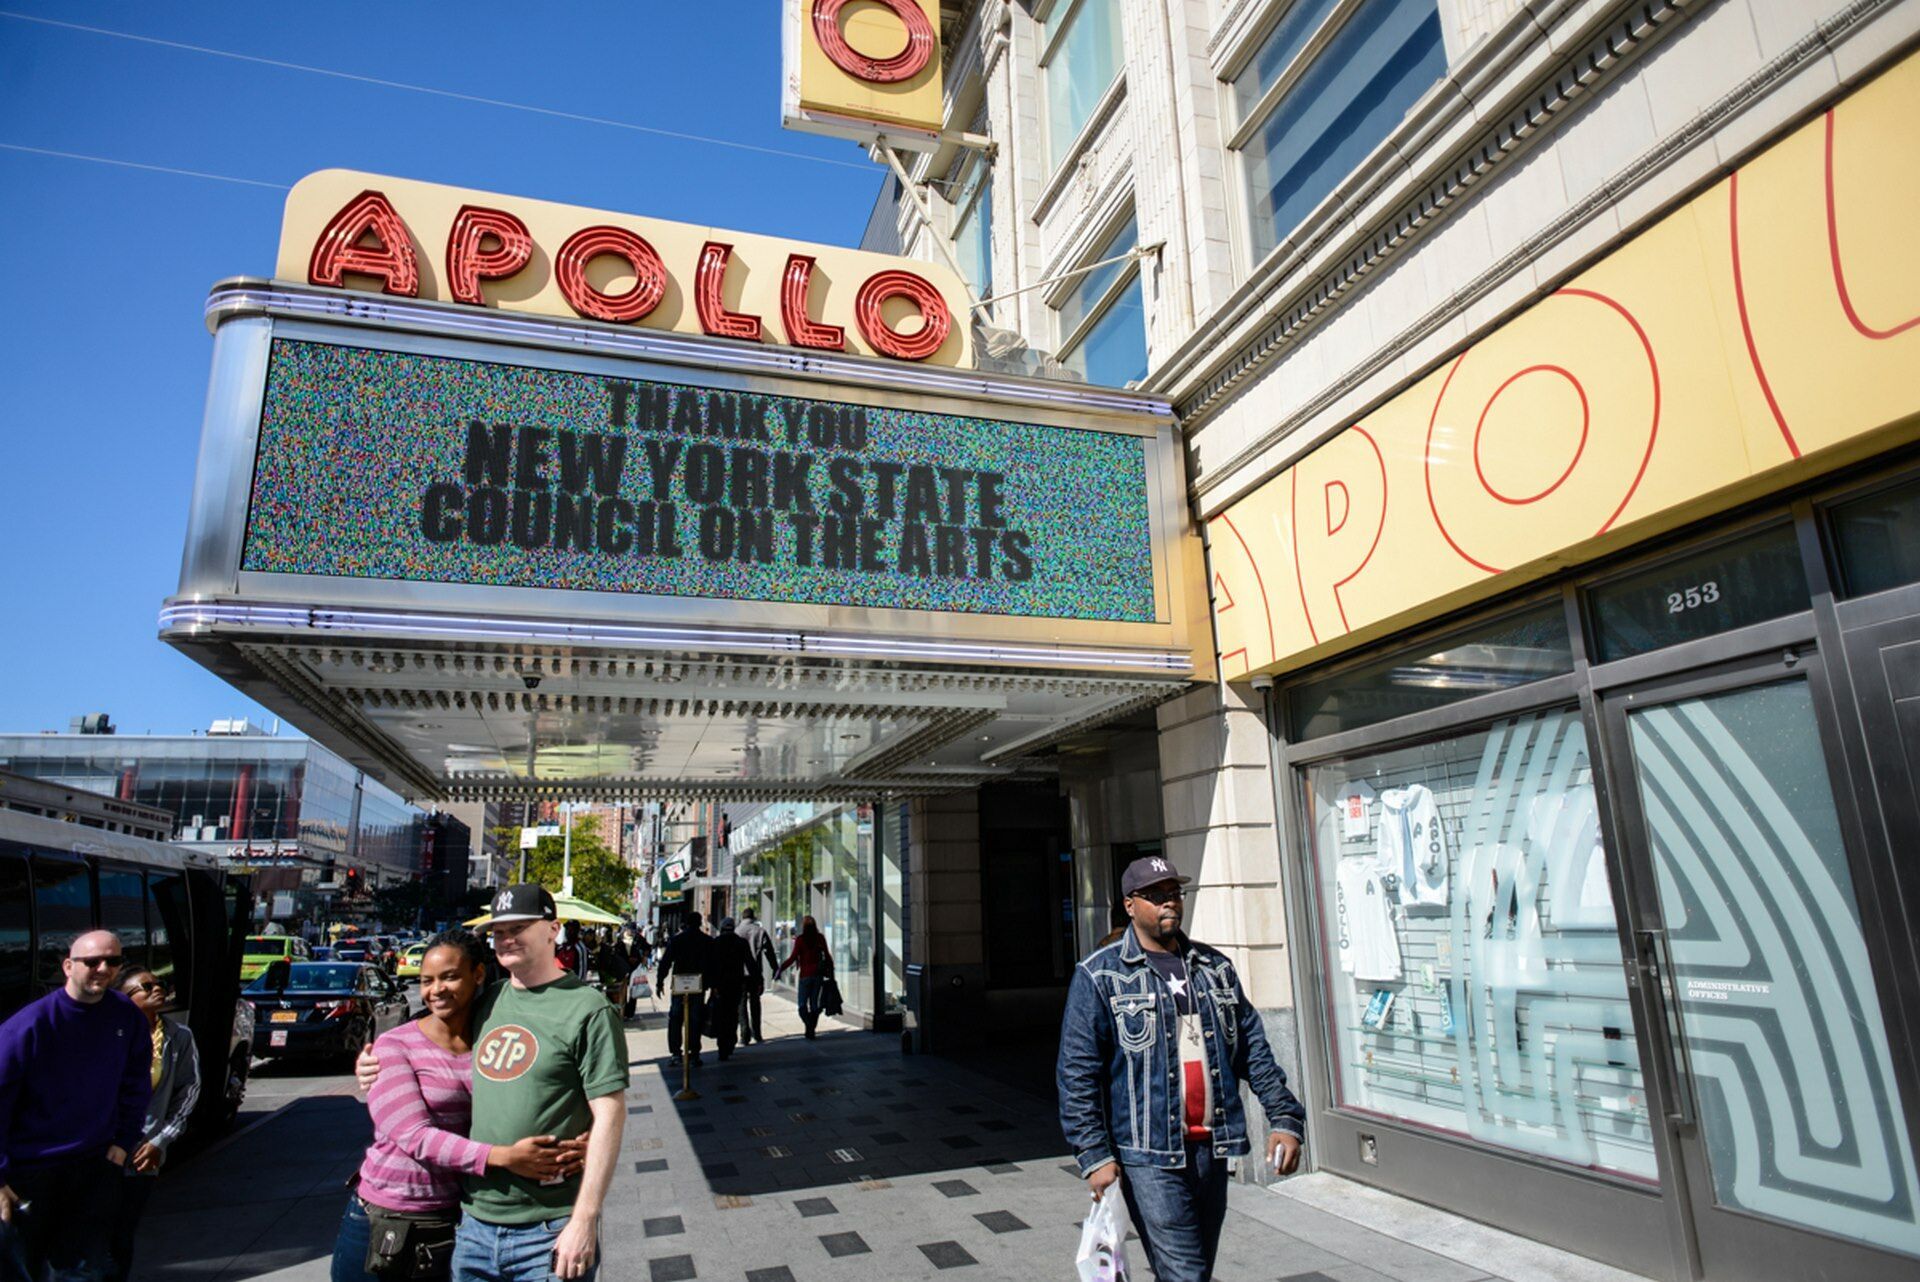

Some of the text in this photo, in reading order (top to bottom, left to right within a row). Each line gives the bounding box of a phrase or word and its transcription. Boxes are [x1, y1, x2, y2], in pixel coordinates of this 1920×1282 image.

[308, 189, 950, 361] APOLLO
[606, 383, 866, 449] THANK YOU
[465, 420, 1006, 528] NEW YORK STATE
[422, 482, 1033, 582] COUNCIL ON THE ARTS
[1667, 581, 1720, 614] 253
[1150, 858, 1168, 872] NY
[496, 890, 514, 912] NY
[1687, 981, 1770, 993] ADMINISTRATIVE
[1688, 989, 1729, 1001] OFFICES
[480, 1031, 526, 1071] STP
